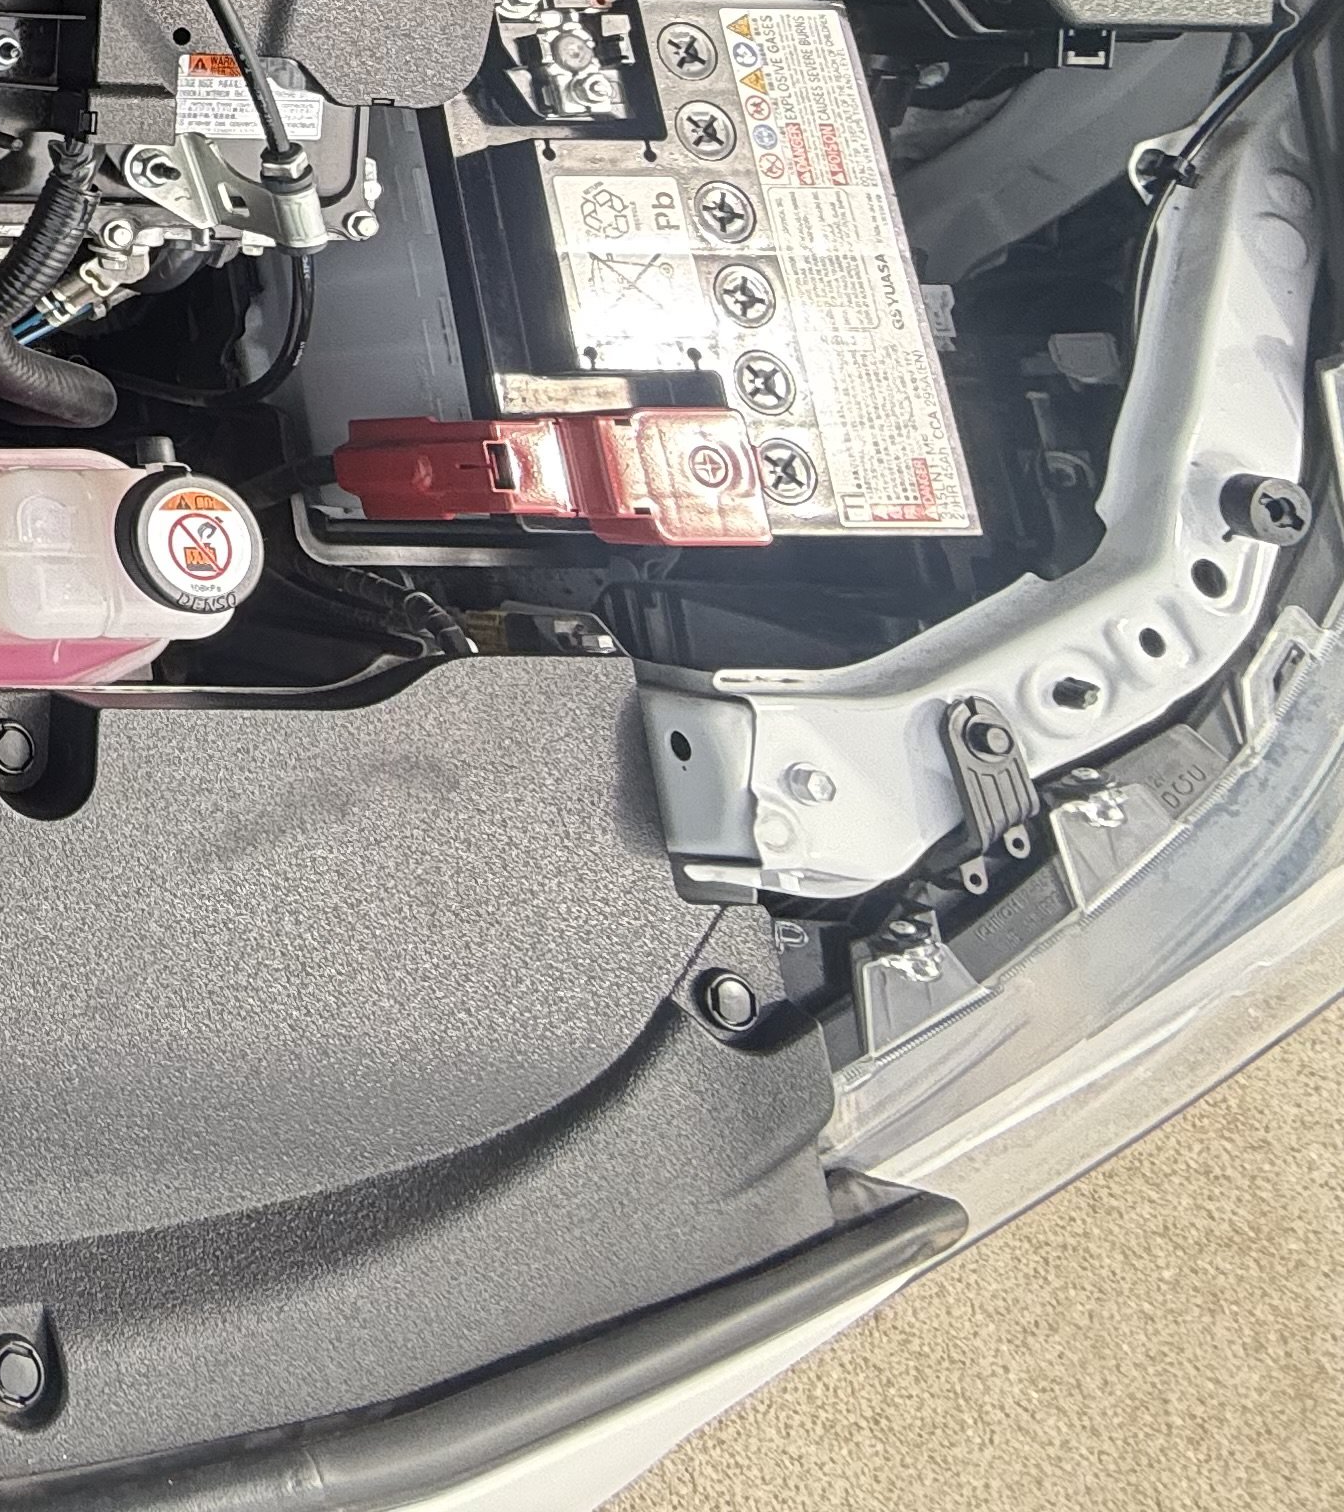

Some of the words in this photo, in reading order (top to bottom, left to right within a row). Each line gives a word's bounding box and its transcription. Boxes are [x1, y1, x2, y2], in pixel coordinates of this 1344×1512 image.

[762, 15, 781, 54] GASES
[795, 15, 812, 46] BURNS
[804, 48, 820, 82] SEVERE
[773, 58, 798, 121] EXPLOSIVE
[813, 85, 831, 121] CAUSES
[786, 123, 809, 172] DANGER
[819, 124, 843, 171] POISON
[651, 191, 680, 231] Pb
[874, 254, 899, 308] YUASA
[928, 411, 945, 440] CCA
[913, 459, 934, 501] DANGER
[938, 448, 955, 479] 45Ah
[176, 591, 237, 612] DENSO
[774, 919, 810, 955] P
